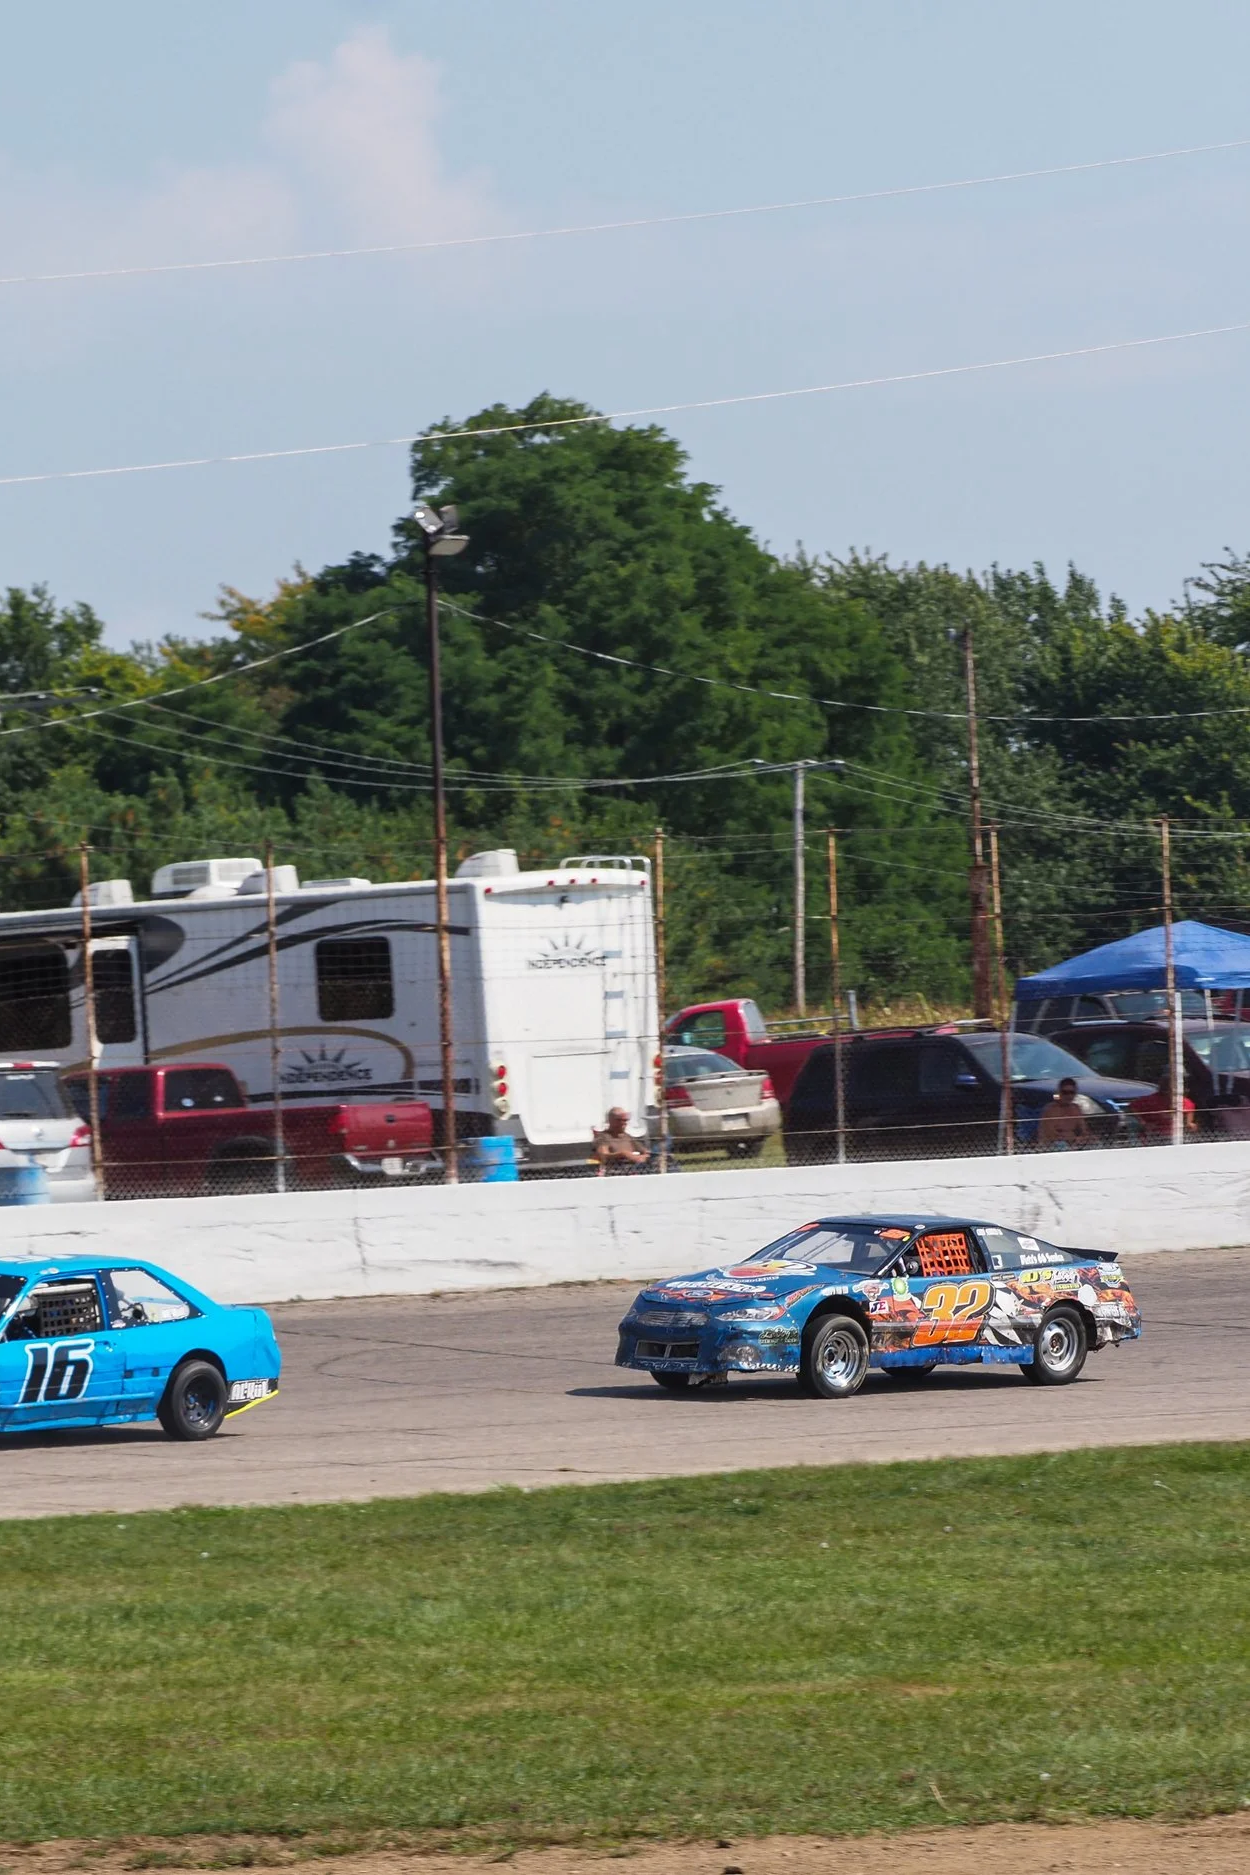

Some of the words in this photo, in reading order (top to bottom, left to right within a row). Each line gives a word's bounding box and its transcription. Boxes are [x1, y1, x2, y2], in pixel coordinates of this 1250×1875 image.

[527, 955, 607, 969] INDEPENDENCE
[277, 1068, 373, 1084] NDEPENDENCE
[870, 1301, 886, 1314] JE
[911, 1280, 994, 1346] 32
[17, 1339, 94, 1405] 16
